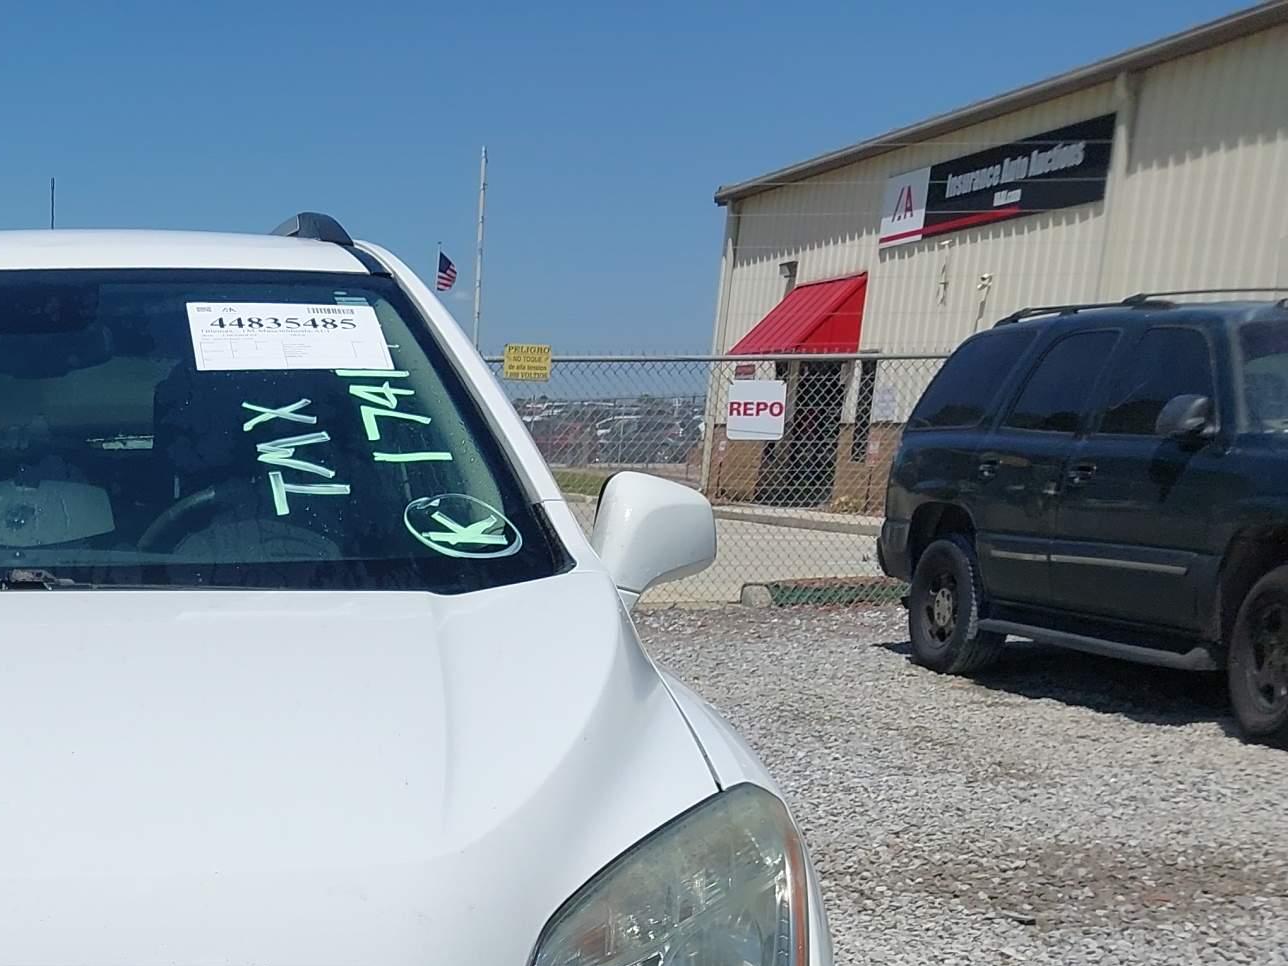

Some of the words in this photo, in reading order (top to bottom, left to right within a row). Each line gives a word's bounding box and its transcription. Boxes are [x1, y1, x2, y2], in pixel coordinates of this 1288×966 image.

[945, 163, 1001, 198] Insurance
[210, 316, 357, 330] 44835485
[508, 345, 550, 353] PELIGRO
[728, 401, 784, 417] REPO
